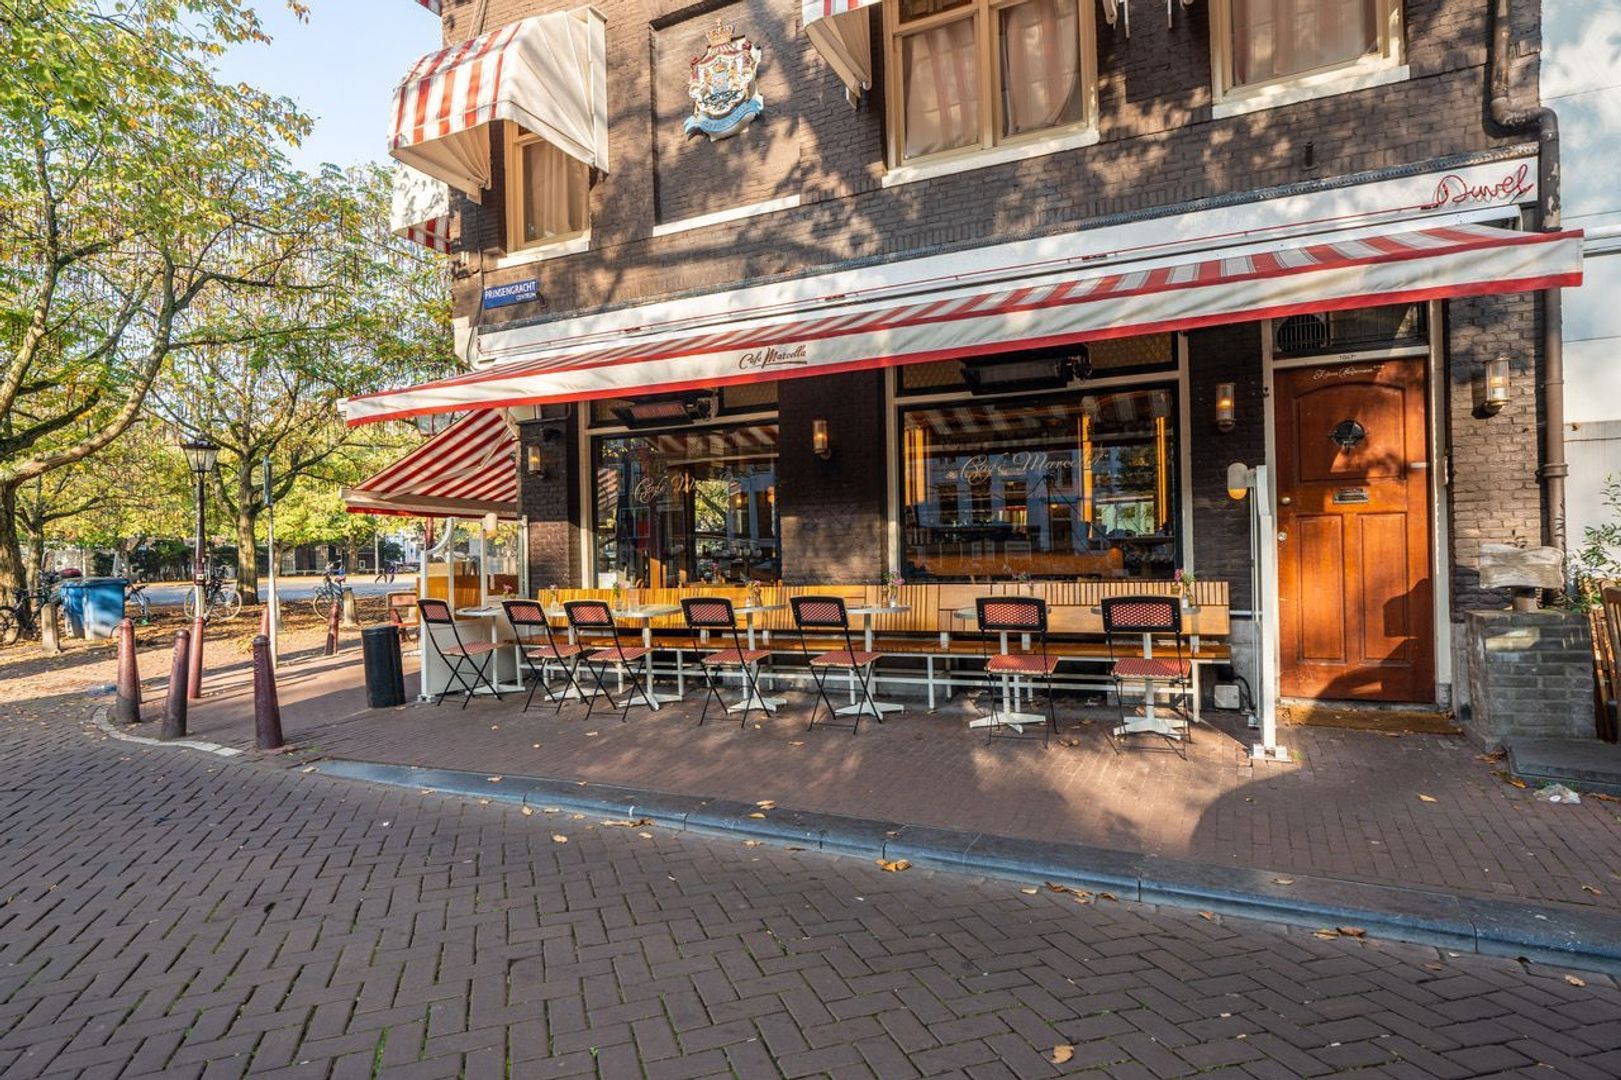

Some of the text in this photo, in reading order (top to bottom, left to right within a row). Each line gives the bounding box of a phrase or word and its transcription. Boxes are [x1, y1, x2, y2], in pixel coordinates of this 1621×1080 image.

[1436, 164, 1534, 204] Duvel
[484, 281, 537, 299] PRINSENGRACHT
[761, 345, 807, 369] Marcella
